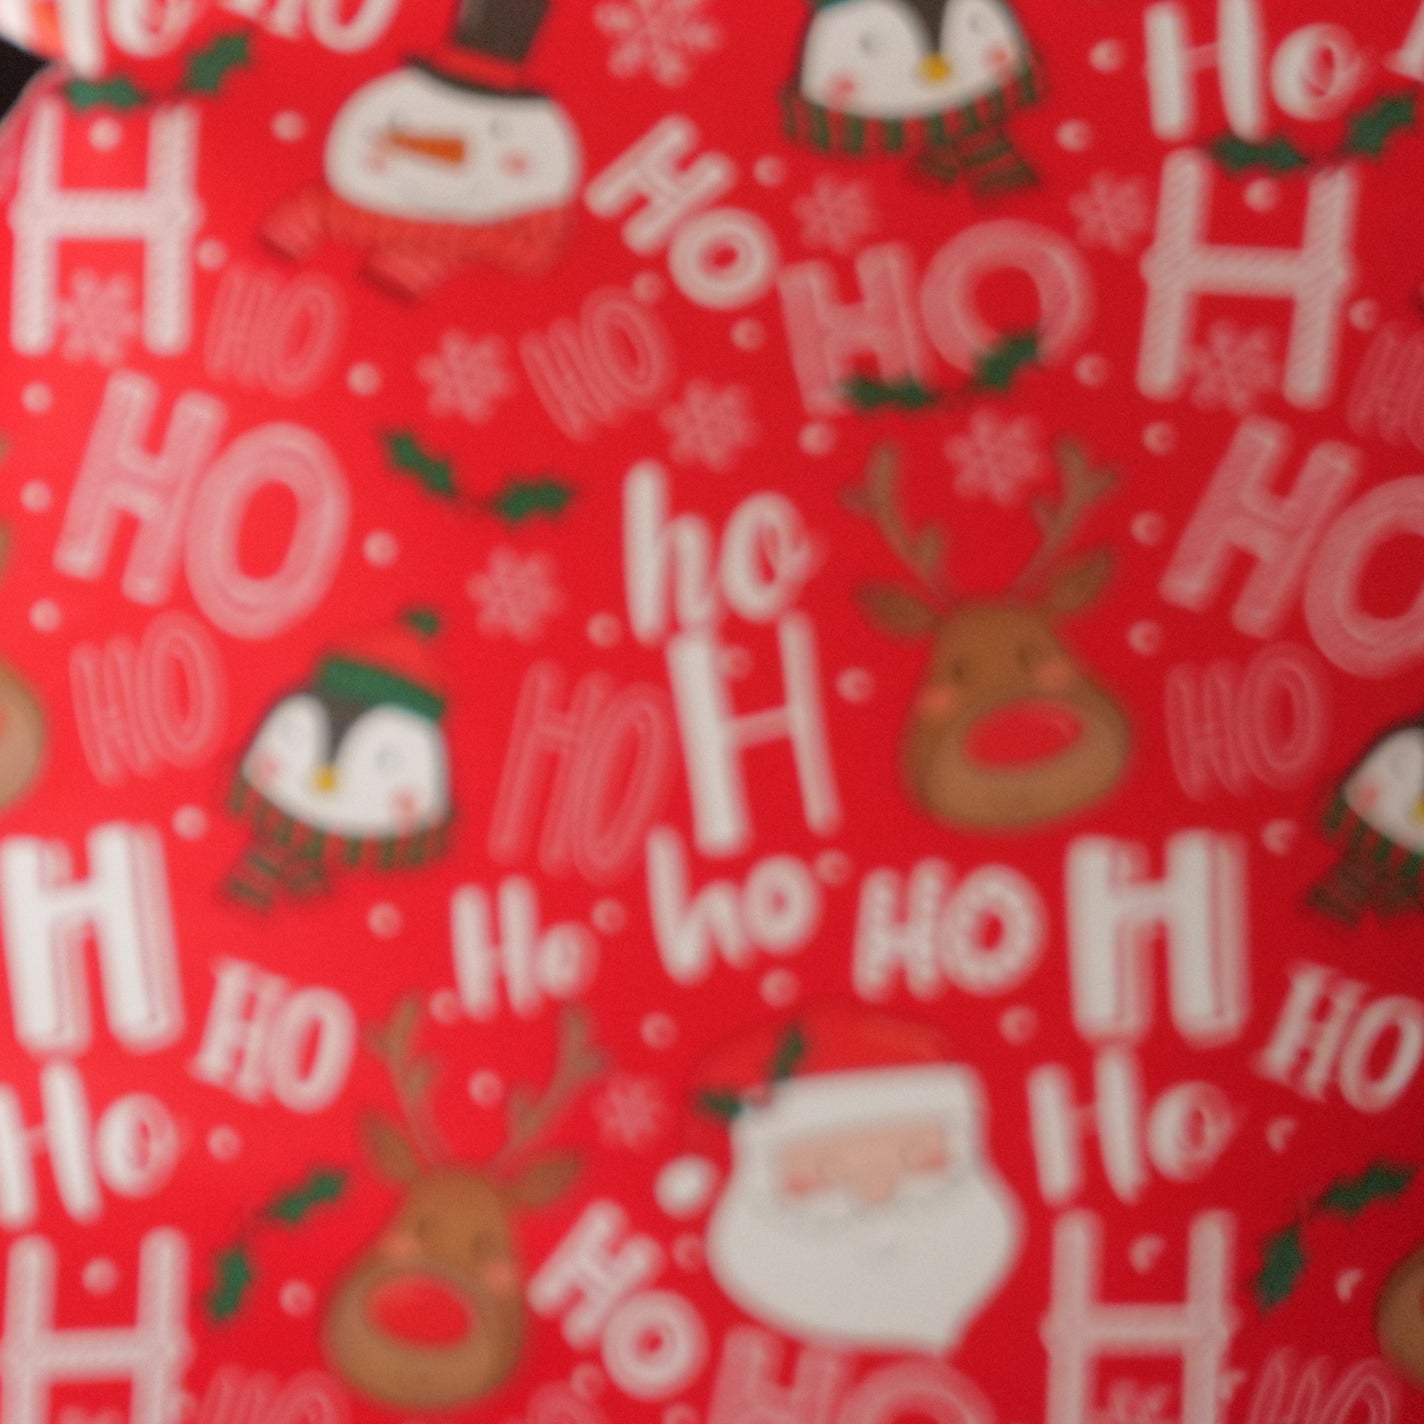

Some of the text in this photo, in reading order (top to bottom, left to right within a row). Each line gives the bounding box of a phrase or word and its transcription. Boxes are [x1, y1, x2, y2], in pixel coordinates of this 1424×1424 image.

[9, 96, 207, 358] H
[584, 113, 780, 311] HO
[1136, 146, 1359, 409] H
[203, 266, 345, 400] HO
[517, 284, 675, 443] HO
[777, 218, 1097, 416] HO
[54, 371, 350, 640] HO
[622, 461, 827, 647] ho
[1158, 415, 1424, 677] HO
[69, 612, 228, 789] HO
[487, 660, 677, 888] HO
[666, 610, 841, 857] H
[1164, 640, 1331, 802] HO
[451, 875, 600, 1021] Ho
[646, 824, 824, 985] ho
[852, 856, 1047, 1003] HO
[1064, 828, 1253, 1050] H
[187, 955, 358, 1115] HO
[1027, 1044, 1240, 1206] Ho
[1249, 956, 1424, 1114] HO
[526, 1198, 709, 1402] HO
